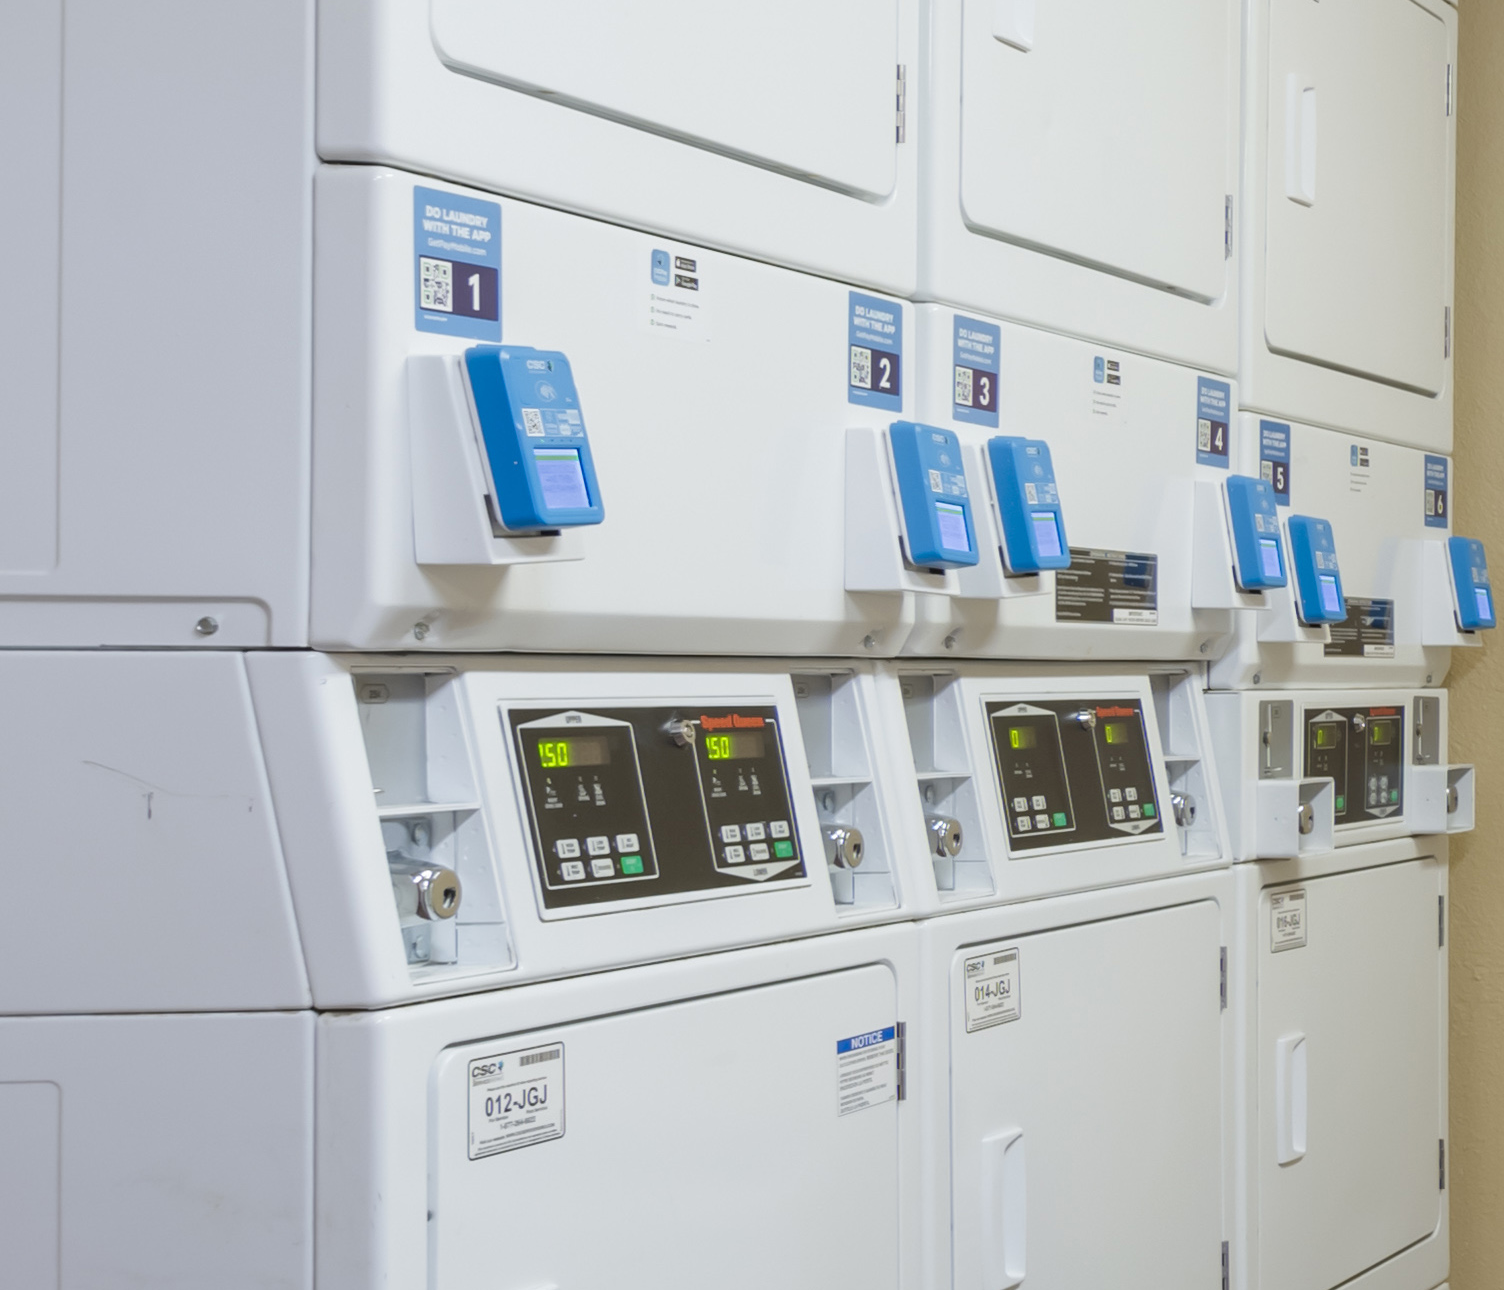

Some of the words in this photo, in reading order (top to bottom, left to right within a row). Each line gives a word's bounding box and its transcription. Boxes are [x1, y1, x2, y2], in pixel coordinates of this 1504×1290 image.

[425, 204, 441, 218] DO
[443, 208, 488, 229] LAUNDRY
[423, 219, 449, 235] WITH
[450, 225, 471, 239] THE
[471, 229, 491, 243] APP
[467, 273, 480, 312] 1
[853, 316, 870, 329] WITH
[870, 320, 883, 332] THE
[883, 324, 896, 335] APP
[855, 305, 865, 315] DO
[866, 308, 894, 323] LAUNDRY
[526, 360, 546, 370] CSC
[879, 357, 891, 388] 2
[979, 376, 990, 406] 3
[1215, 427, 1223, 451] 4
[1277, 467, 1284, 490] 5
[1437, 494, 1444, 515] 6
[975, 979, 1010, 1002] 014-JGJ
[851, 1031, 883, 1049] NOTICE
[471, 1063, 496, 1078] CSC
[485, 1084, 547, 1117] 012-JGJ
